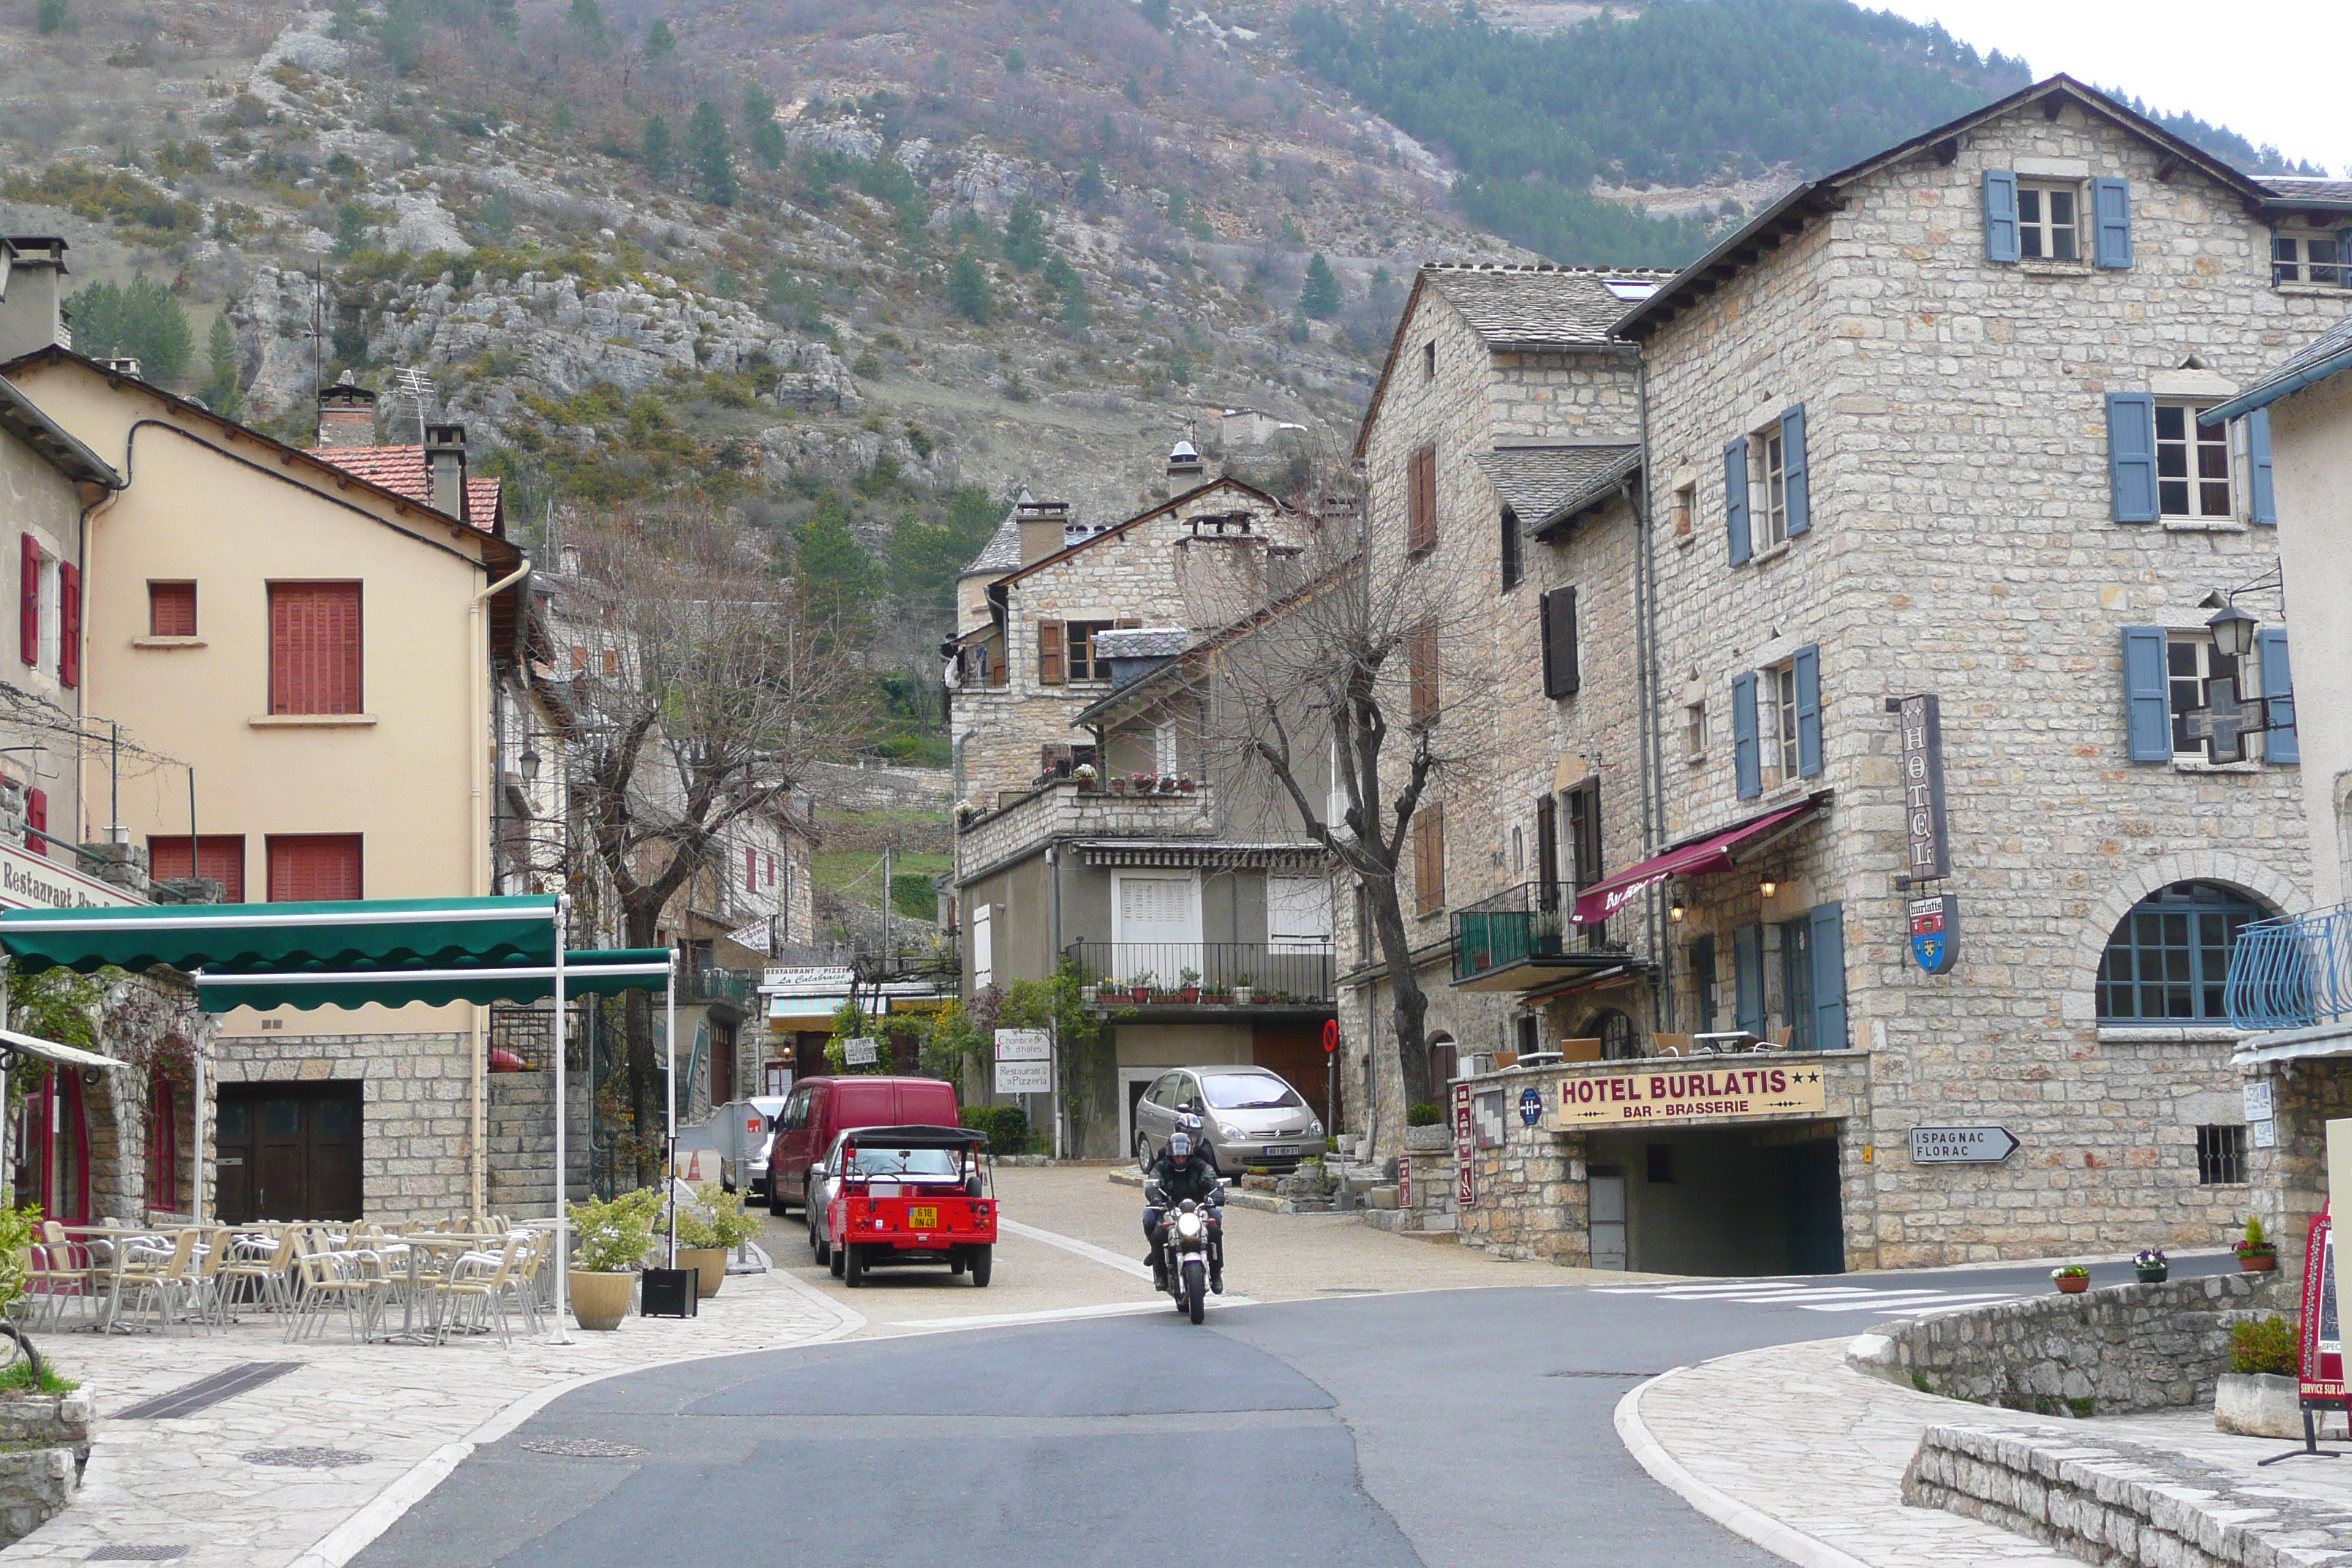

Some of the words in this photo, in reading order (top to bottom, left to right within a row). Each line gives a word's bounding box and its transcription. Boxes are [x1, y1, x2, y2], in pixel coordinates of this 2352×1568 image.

[4, 862, 72, 908] Restaurant
[1910, 900, 1942, 915] burlatis
[777, 976, 791, 984] La
[795, 973, 845, 984] Calabraise
[998, 1035, 1039, 1044] Chambres
[1000, 1066, 1041, 1076] Restaurant
[1012, 1076, 1047, 1085] Pizzeria
[1562, 1077, 1642, 1104] HOTEL
[1650, 1069, 1787, 1099] BURLATIS
[1622, 1105, 1653, 1119] BAR
[1665, 1100, 1749, 1116] BRASSERIE
[1915, 1132, 1985, 1143] ISPAGNAC
[1917, 1146, 1970, 1157] FLORAC
[918, 1208, 932, 1216] 618
[2300, 1383, 2323, 1394] SERVICE
[2323, 1384, 2336, 1395] SUR
